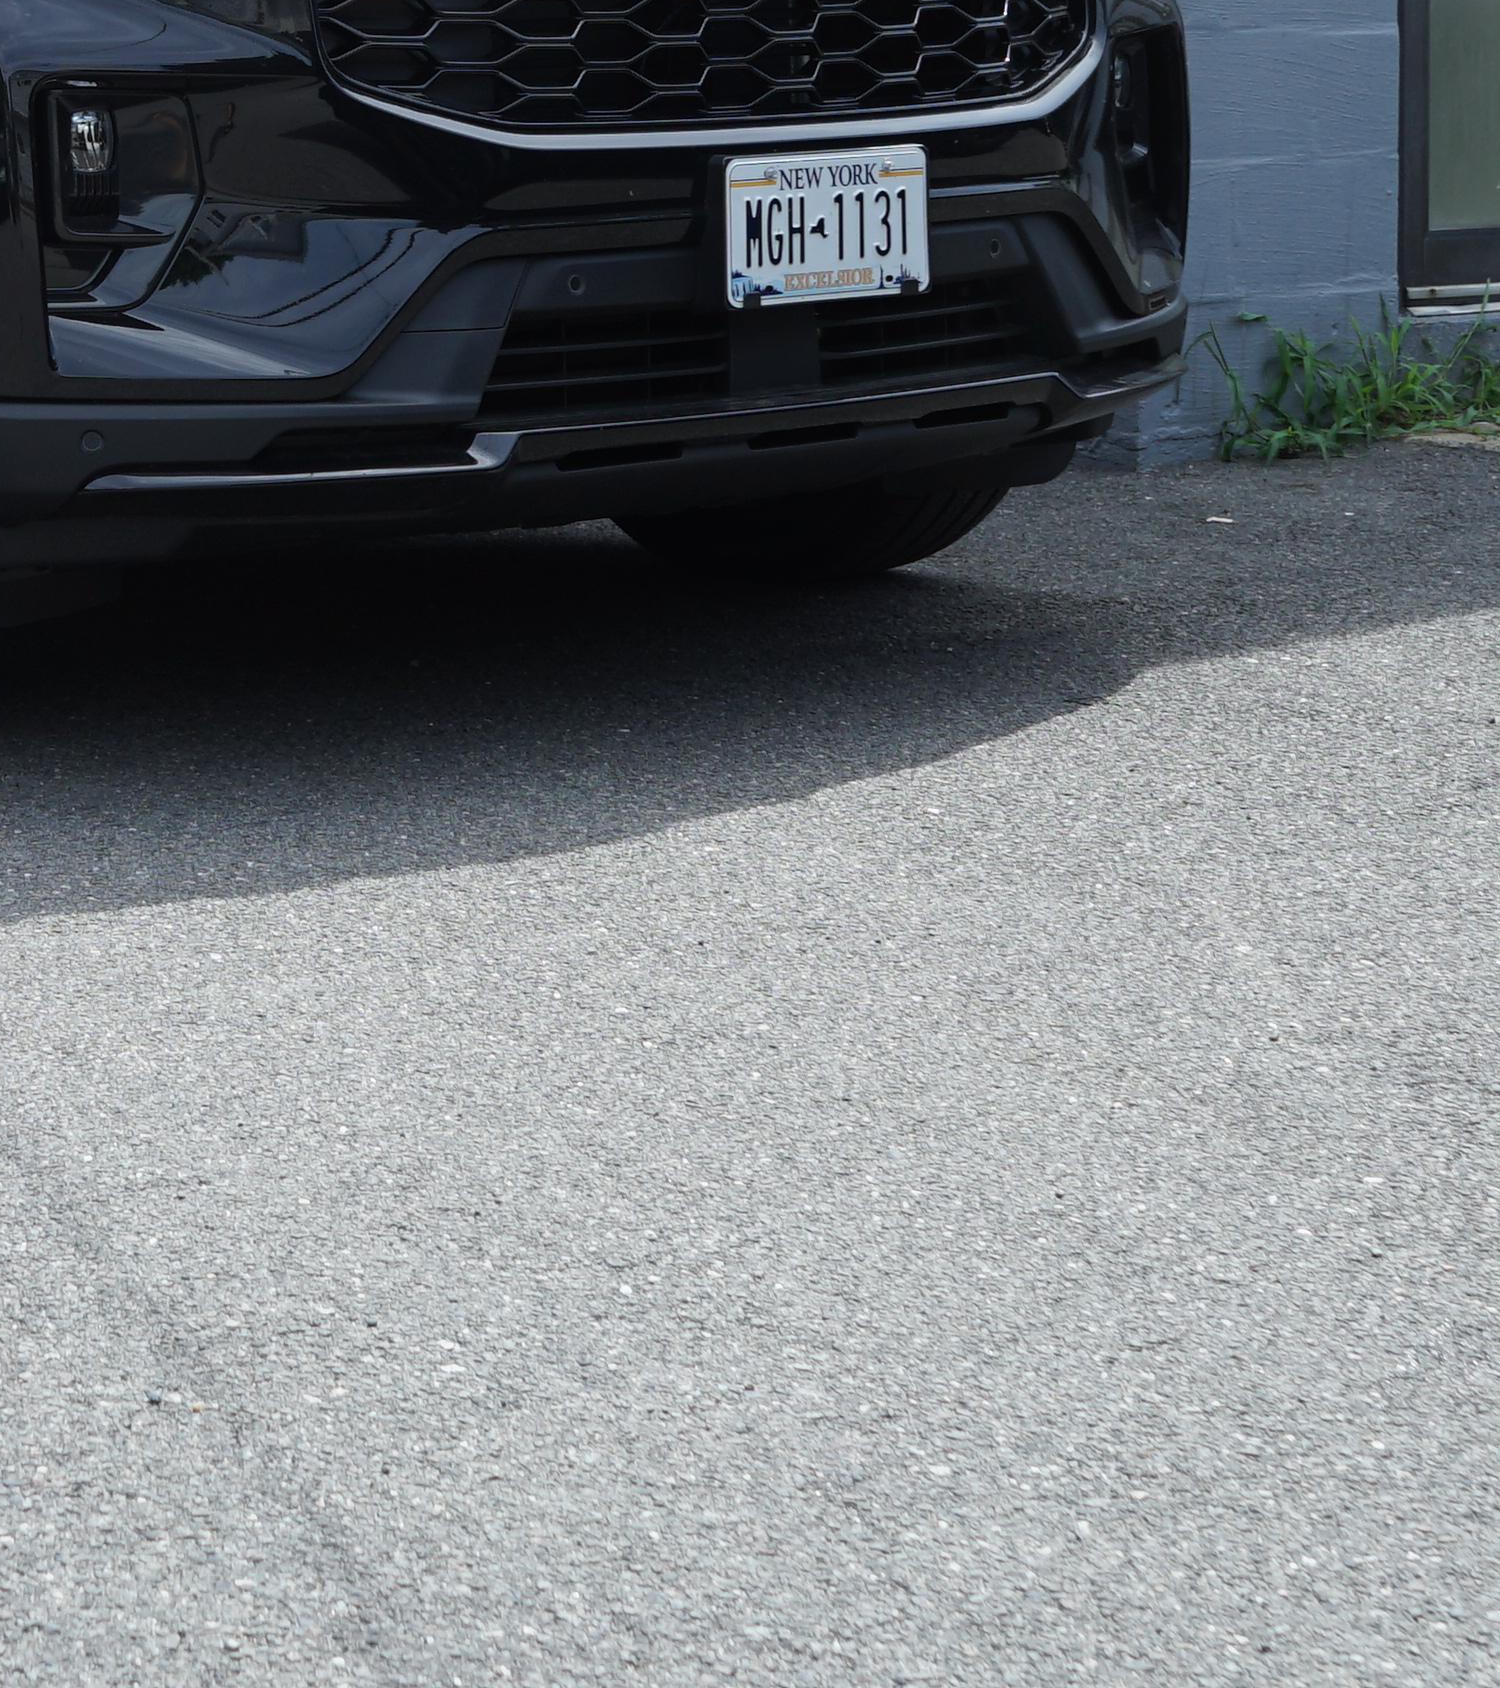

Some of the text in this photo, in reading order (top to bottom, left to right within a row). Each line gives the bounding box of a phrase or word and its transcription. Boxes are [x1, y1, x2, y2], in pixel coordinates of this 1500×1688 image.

[779, 162, 879, 191] NEW YORK
[783, 266, 876, 292] EXCELSIOR
